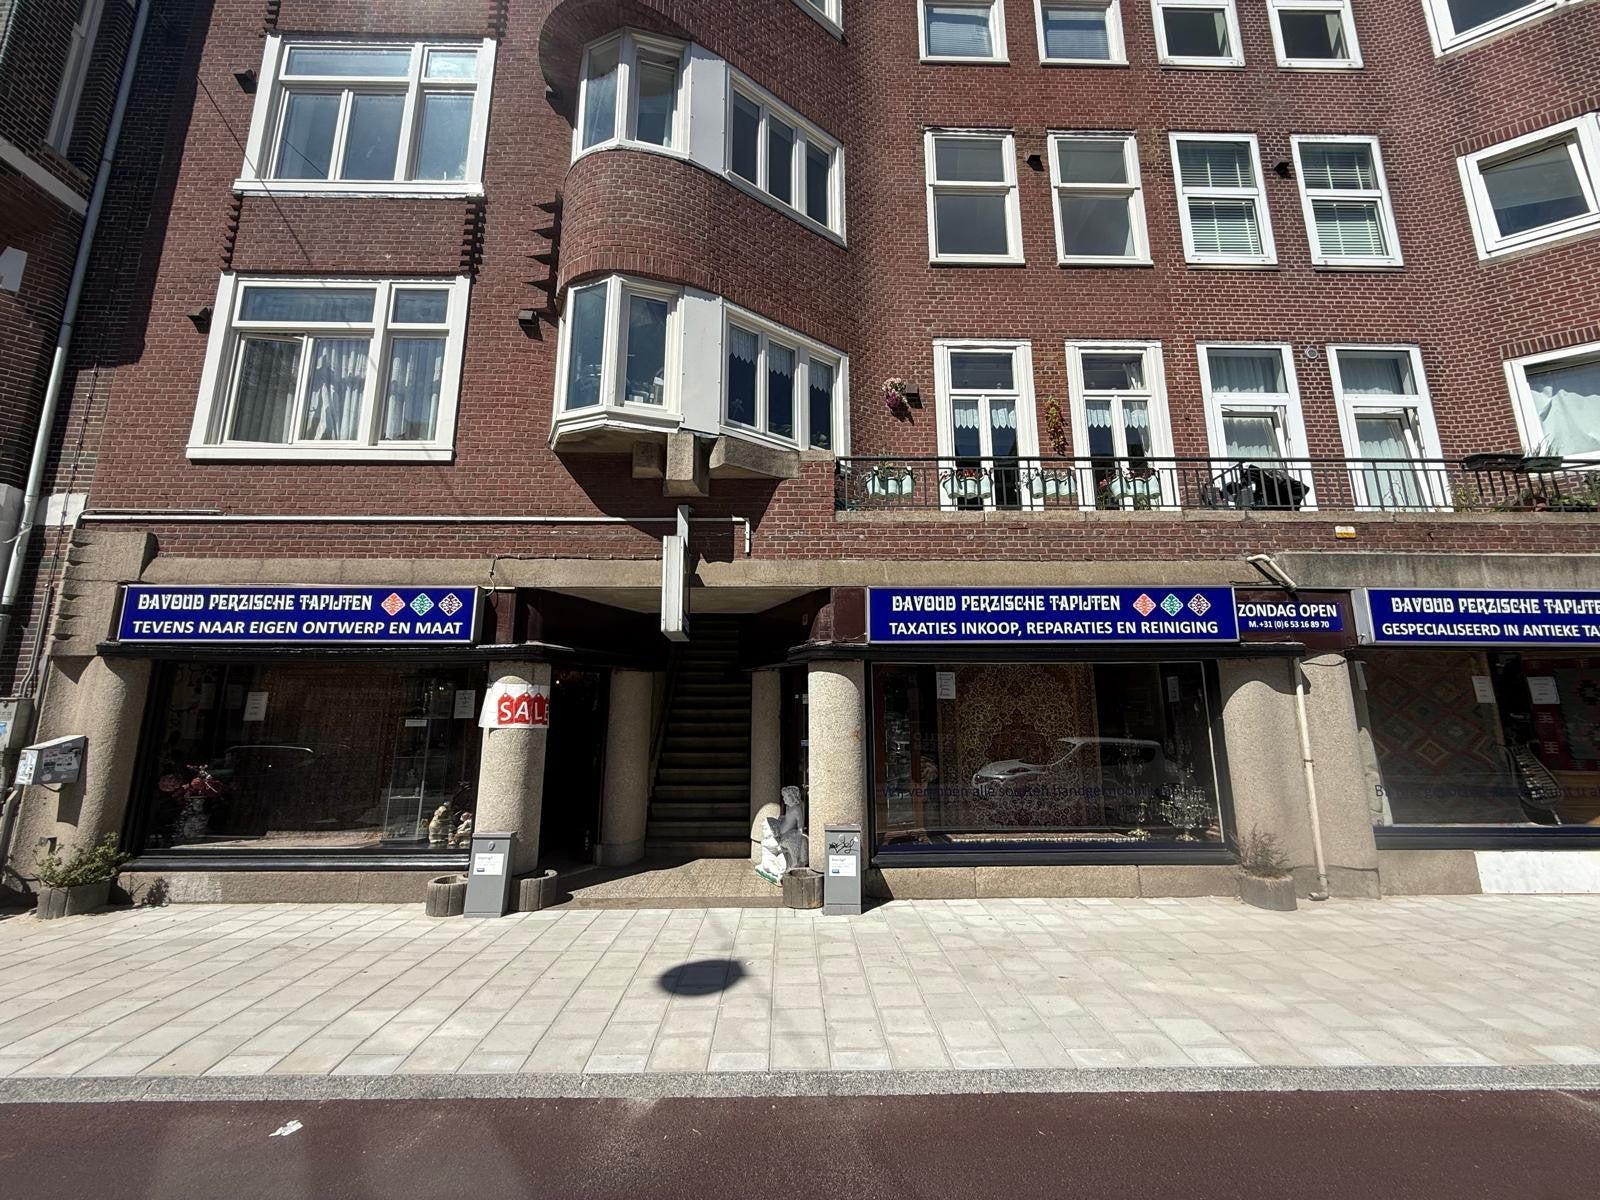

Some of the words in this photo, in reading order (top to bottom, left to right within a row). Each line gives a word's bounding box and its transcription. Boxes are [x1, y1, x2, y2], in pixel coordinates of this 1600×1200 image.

[138, 594, 205, 610] DAVOUD
[208, 594, 295, 611] PERZISCHE
[299, 595, 373, 611] TAPIJTEN
[892, 596, 957, 611] DAVOUD
[961, 596, 1045, 612] PERZISCHE
[1049, 595, 1121, 611] TAPIJTEN
[1237, 603, 1297, 617] ZONDAG
[1299, 604, 1338, 617] OPEN
[1392, 598, 1454, 613] DAVOUD
[1458, 598, 1542, 614] PERZISCHE
[133, 620, 194, 633] TEVENS
[198, 621, 245, 634] NAAR
[249, 621, 298, 634] EIGEN
[302, 621, 385, 634] ONTWERP
[388, 622, 411, 634] EN
[415, 622, 463, 635] MAAT
[889, 622, 957, 635] TAXATIES
[961, 622, 1022, 637] INKOOP,
[1027, 622, 1113, 635] REPARATIES
[1116, 622, 1137, 634] EN
[1141, 621, 1218, 634] REINIGING
[1290, 620, 1300, 628] 53
[1300, 620, 1310, 628] 16
[1310, 620, 1320, 628] 89
[1321, 620, 1330, 628] 70
[1382, 623, 1500, 636] GESPECIALISEERD
[1503, 624, 1520, 636] IN
[1523, 624, 1581, 637] ANTIEKE
[1582, 625, 1600, 637] TA
